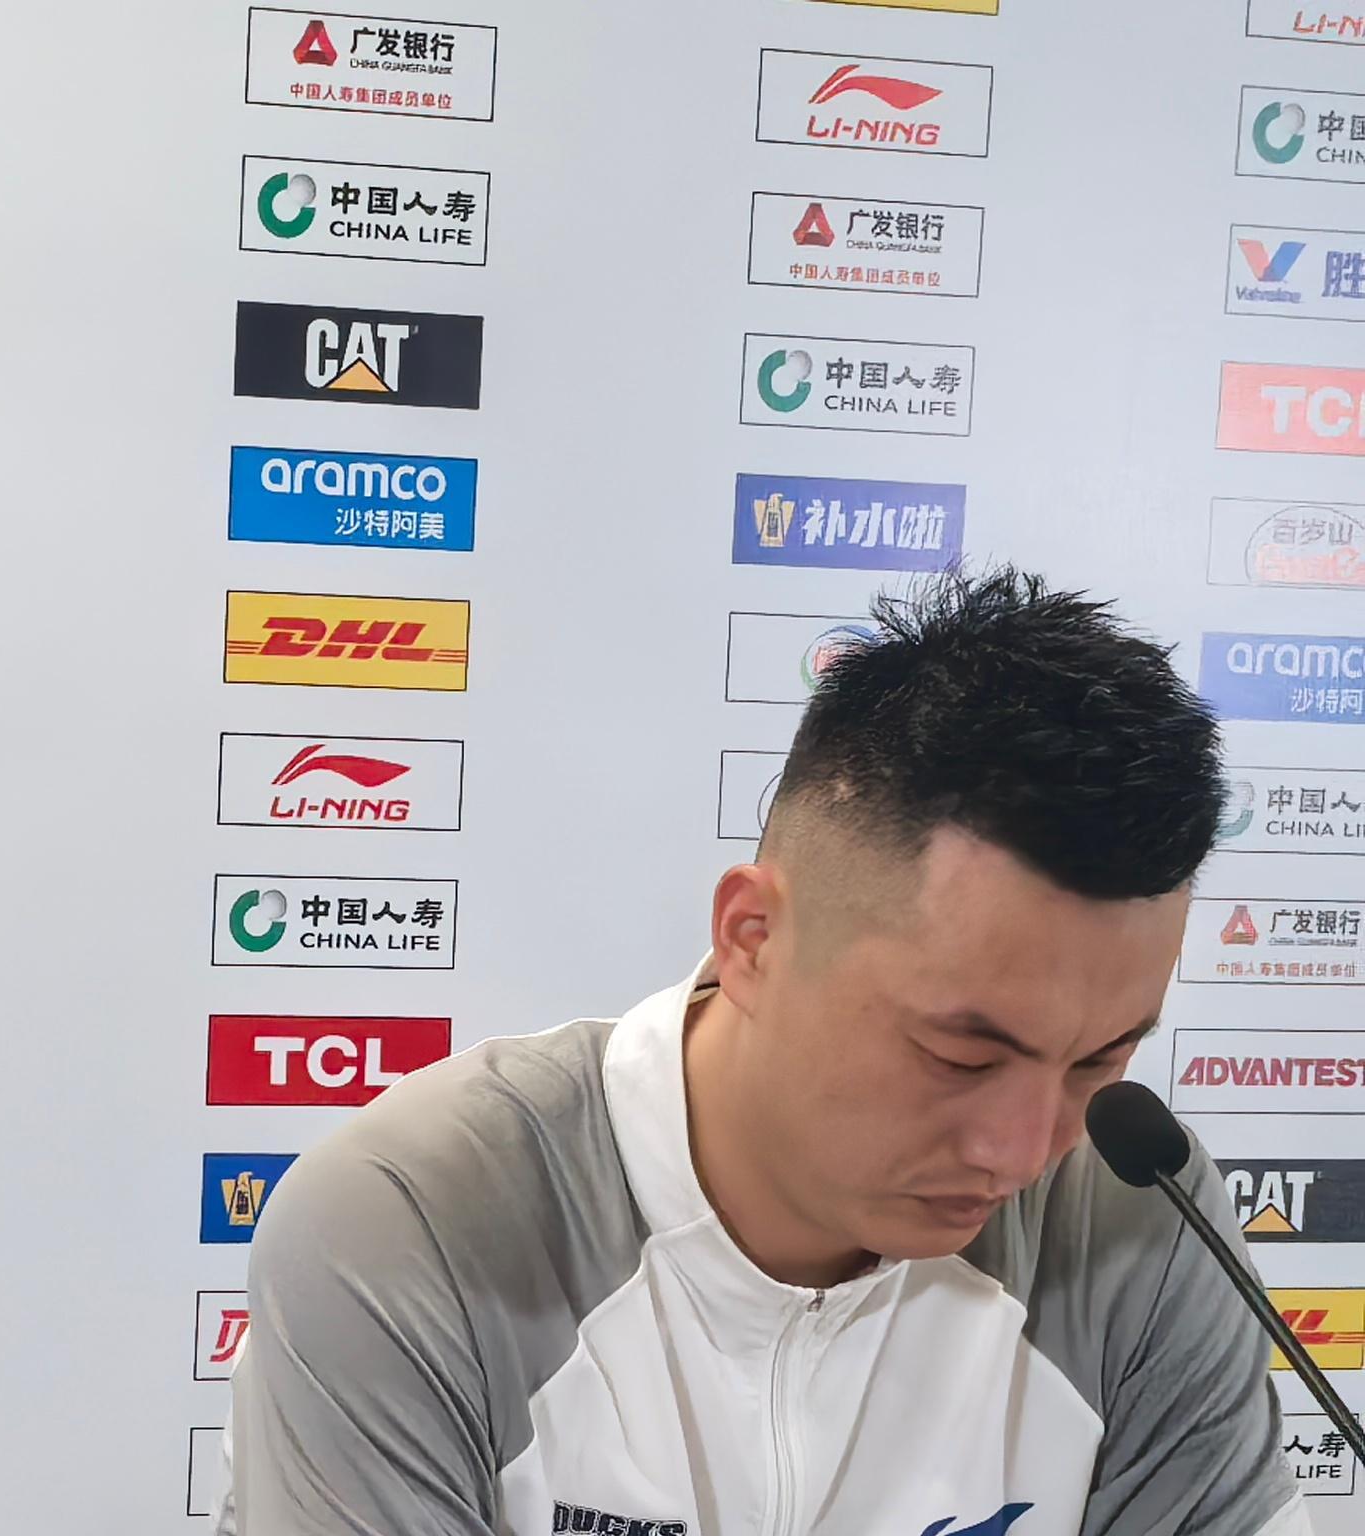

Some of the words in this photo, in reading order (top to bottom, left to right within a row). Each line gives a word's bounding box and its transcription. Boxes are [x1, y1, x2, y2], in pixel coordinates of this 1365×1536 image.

[1293, 11, 1365, 37] LI-N
[350, 27, 454, 61] 广发银行
[807, 115, 940, 145] LI-NING
[1316, 146, 1365, 163] CHIN
[331, 182, 476, 222] 中国人寿
[330, 221, 409, 241] CHINA
[420, 227, 472, 245] LIFE
[847, 209, 944, 241] 广发银行
[1322, 251, 1365, 299] 胜
[305, 319, 409, 391] CAT
[826, 357, 961, 395] 中国人寿
[825, 395, 897, 413] CHINA
[908, 399, 956, 416] LIFE
[1260, 386, 1365, 437] TC
[261, 458, 446, 501] aramco
[335, 508, 444, 539] 沙特阿美
[803, 499, 946, 550] 补水啦
[258, 617, 435, 661] DHL
[1227, 642, 1365, 678] aramc
[1289, 686, 1363, 714] 沙特阿
[270, 797, 409, 821] LI-NING
[1268, 785, 1361, 815] 中国人
[1266, 821, 1334, 836] CHINA
[1344, 823, 1365, 838] LI
[302, 895, 443, 928] 中国人寿
[1270, 909, 1360, 935] 广发银行
[300, 933, 378, 949] CHINA
[388, 935, 439, 950] LIFE
[255, 1035, 403, 1089] TCL
[1224, 1169, 1314, 1232] CAT
[1282, 1432, 1345, 1457] 人寿
[1296, 1465, 1341, 1478] LIFE
